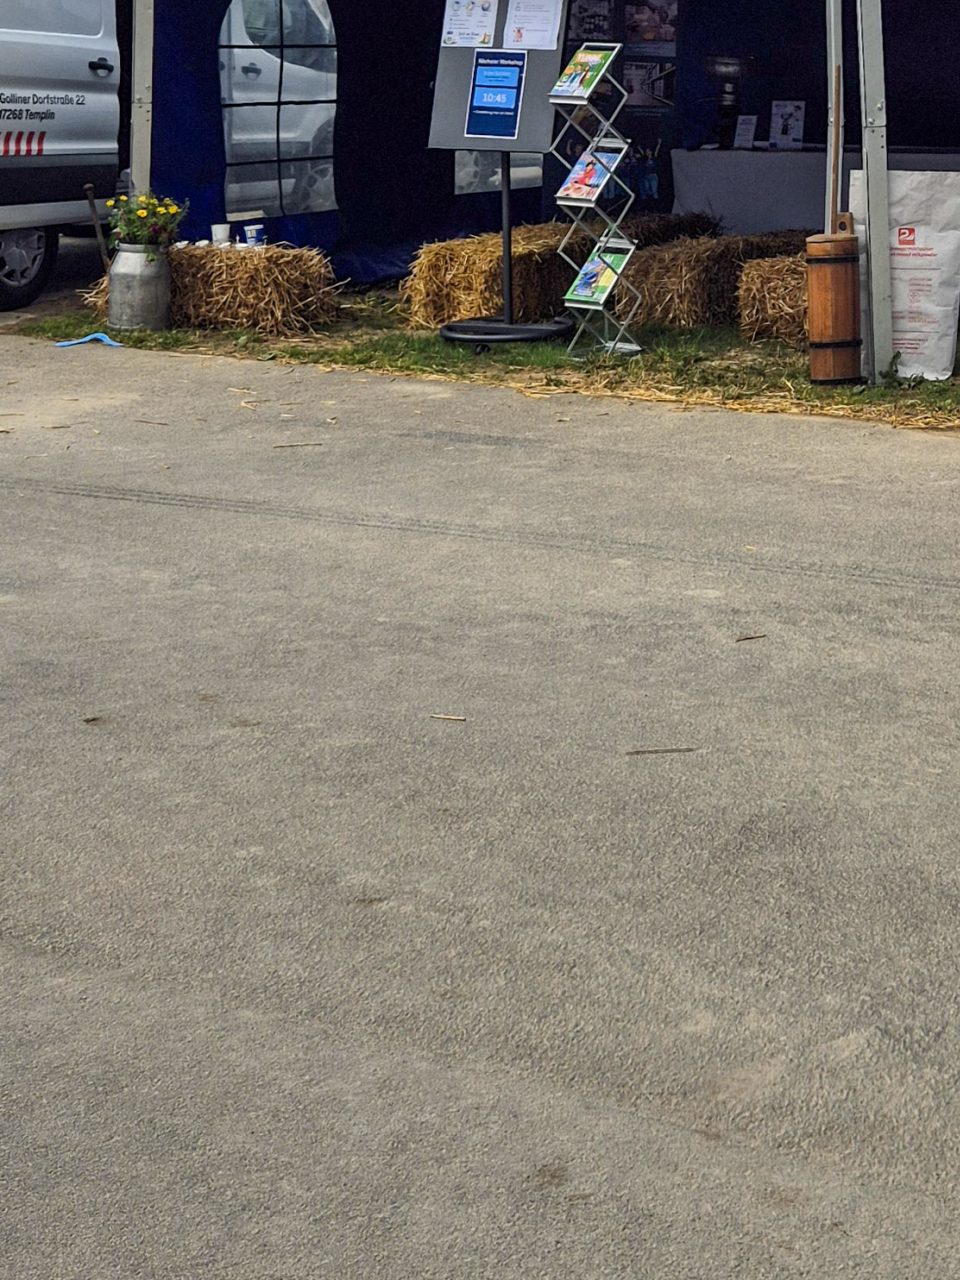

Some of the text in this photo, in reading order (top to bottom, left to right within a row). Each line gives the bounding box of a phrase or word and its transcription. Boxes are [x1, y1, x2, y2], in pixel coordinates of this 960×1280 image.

[0, 92, 86, 105] Golliner Dorfstraße 22
[482, 93, 507, 103] 10:45
[25, 109, 56, 122] Templin
